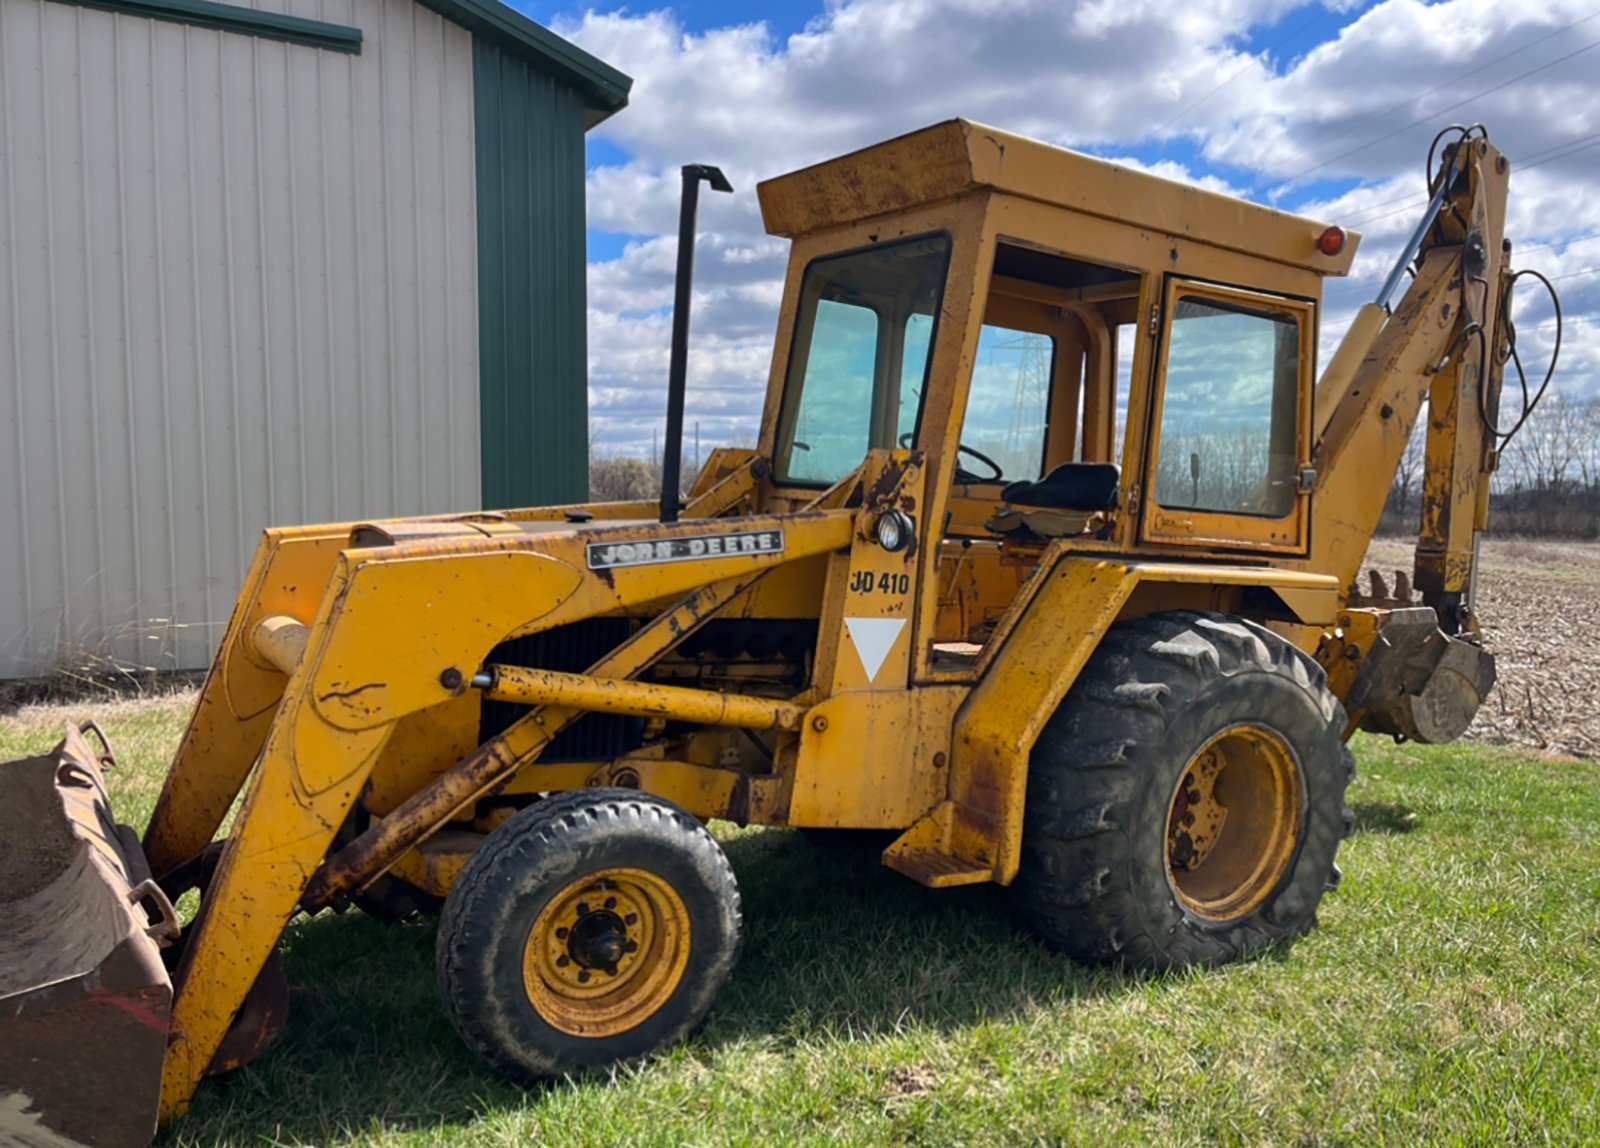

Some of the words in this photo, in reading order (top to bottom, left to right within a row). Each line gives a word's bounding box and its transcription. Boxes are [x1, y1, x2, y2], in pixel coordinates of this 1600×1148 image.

[688, 534, 772, 556] DEERE
[850, 571, 874, 592] JD
[878, 572, 909, 594] 410
